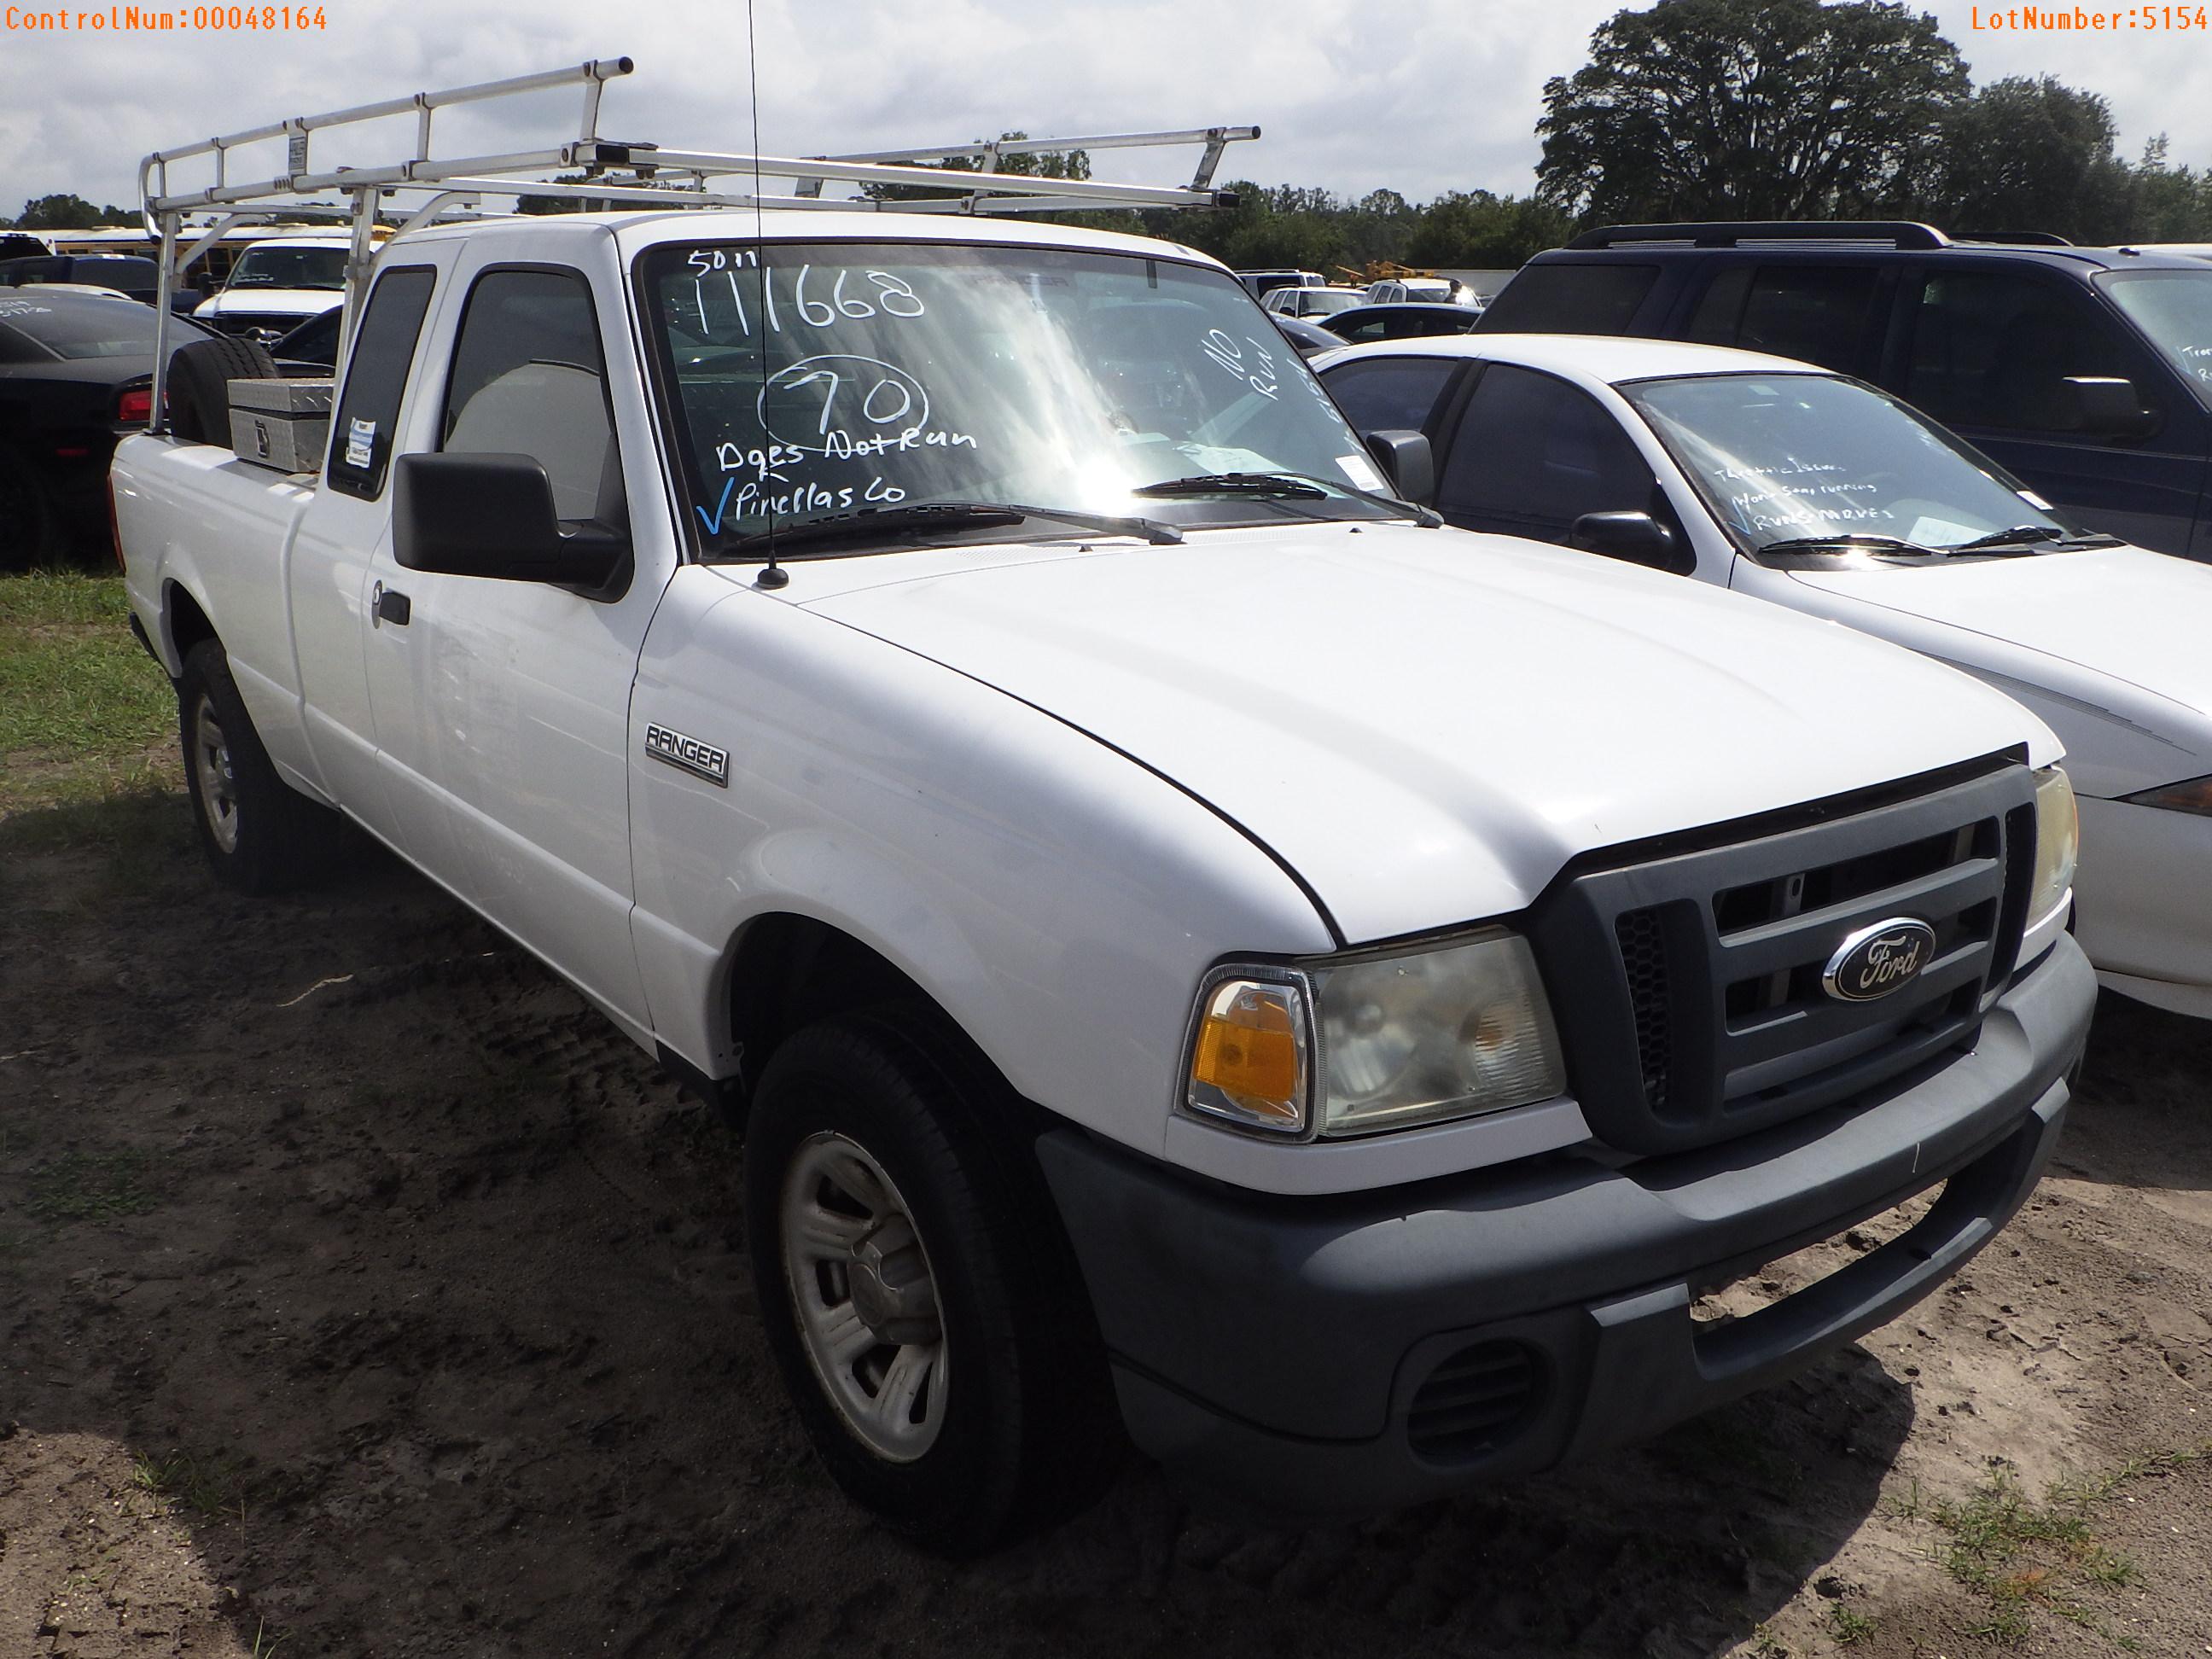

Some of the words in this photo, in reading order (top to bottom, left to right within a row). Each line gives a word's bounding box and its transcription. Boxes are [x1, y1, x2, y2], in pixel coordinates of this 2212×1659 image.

[694, 264, 926, 336] 111668
[783, 370, 911, 435] 70
[646, 725, 725, 773] RANGER
[1859, 934, 1922, 990] Ford
